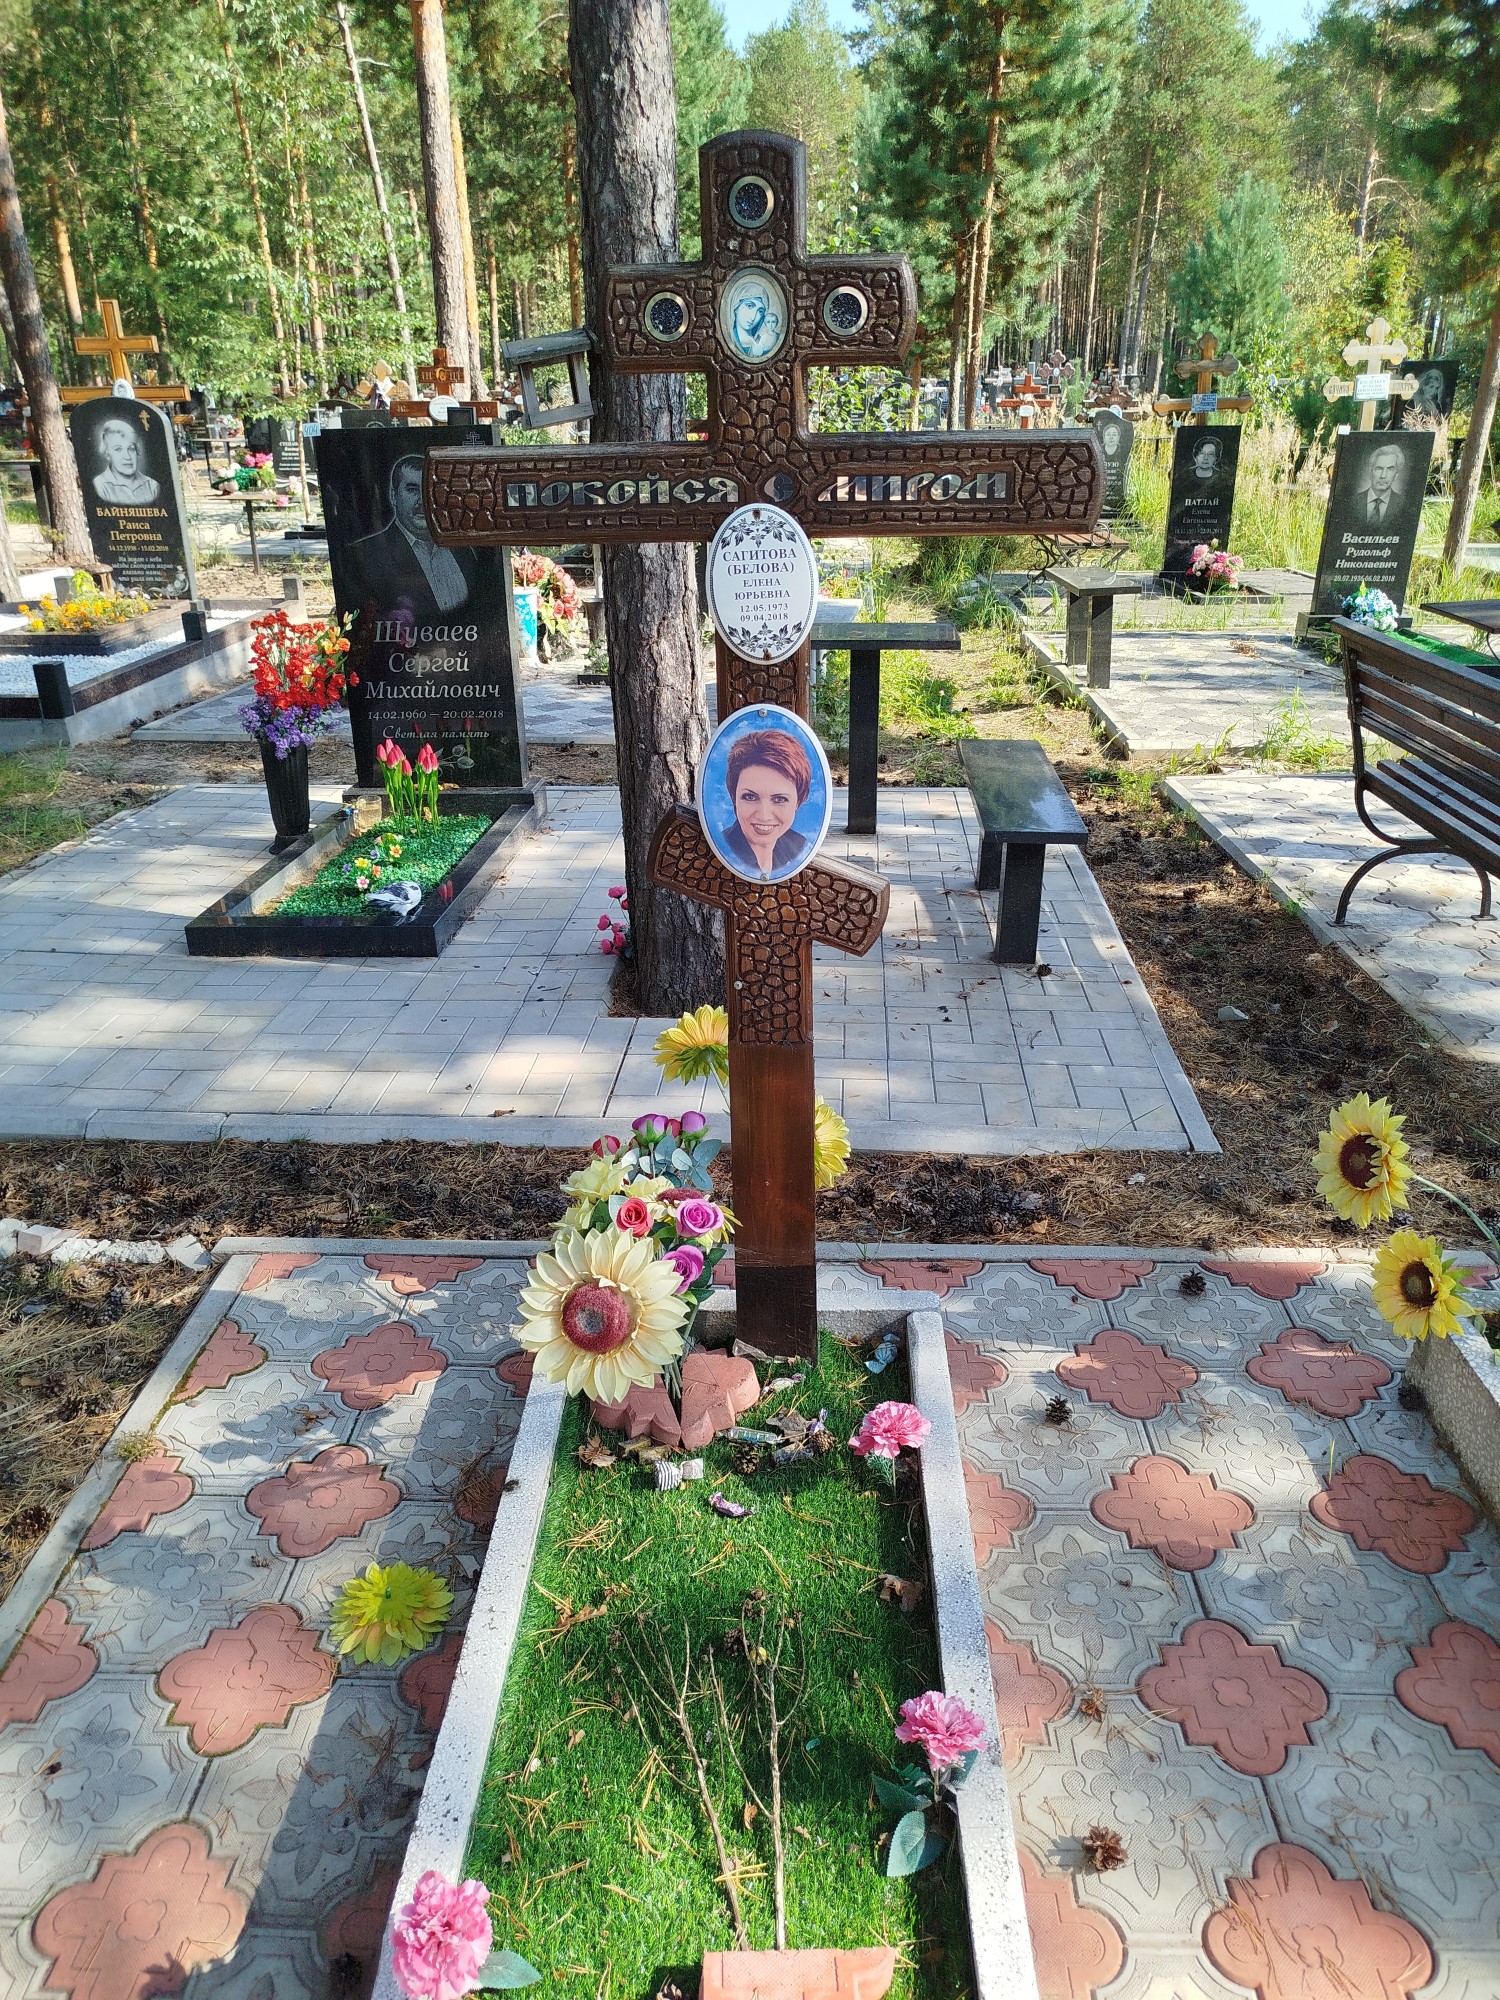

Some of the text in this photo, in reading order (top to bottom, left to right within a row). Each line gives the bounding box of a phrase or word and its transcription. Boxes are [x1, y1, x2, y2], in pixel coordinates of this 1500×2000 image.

[506, 473, 739, 507] ПОКОЙСЯ
[817, 472, 1007, 502] МИРОМ
[1185, 498, 1219, 506] ПАТЛАЙ
[96, 507, 168, 517] БАЙНЯШЕВА
[119, 520, 150, 530] Раиса
[110, 531, 162, 543] Петровна
[1341, 532, 1400, 544] Васильев
[723, 548, 797, 562] САГИТОВА
[1346, 546, 1392, 558] Рудольф
[727, 562, 795, 577] (БЕЛОВА)
[1334, 559, 1398, 569] Николаевич
[743, 578, 781, 588] ЕЛЕНА
[735, 589, 791, 601] ЮРЬЕВНА
[740, 603, 789, 613] 12.05.1973
[740, 613, 789, 622] 09.04.2018
[374, 620, 478, 648] Шуваев
[388, 651, 470, 678] Сергей
[364, 680, 501, 699] Михайлович
[368, 709, 427, 720] 14.02.1960
[443, 708, 504, 719] 20.02.2018
[382, 726, 490, 739] Светлая память
